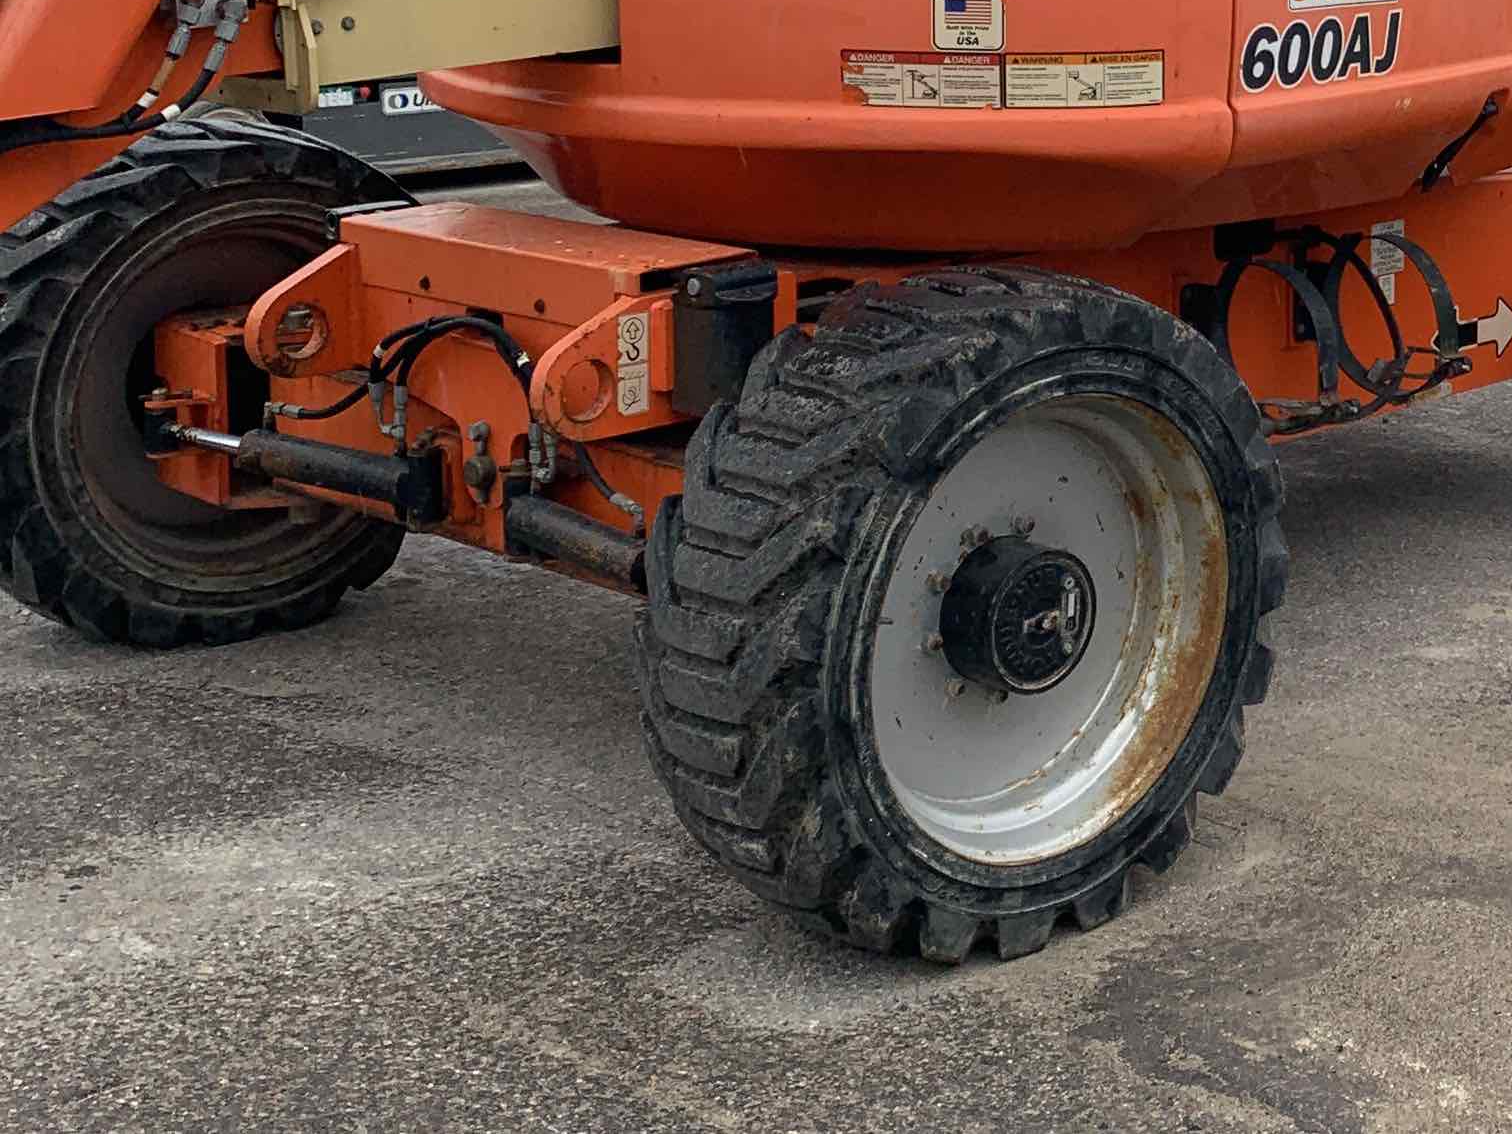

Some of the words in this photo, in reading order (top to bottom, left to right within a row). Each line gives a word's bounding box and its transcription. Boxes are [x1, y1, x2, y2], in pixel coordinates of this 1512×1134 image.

[956, 36, 980, 46] USA
[1241, 11, 1401, 91] 600AJ
[856, 53, 895, 63] DANGER
[951, 56, 990, 65] DANGER
